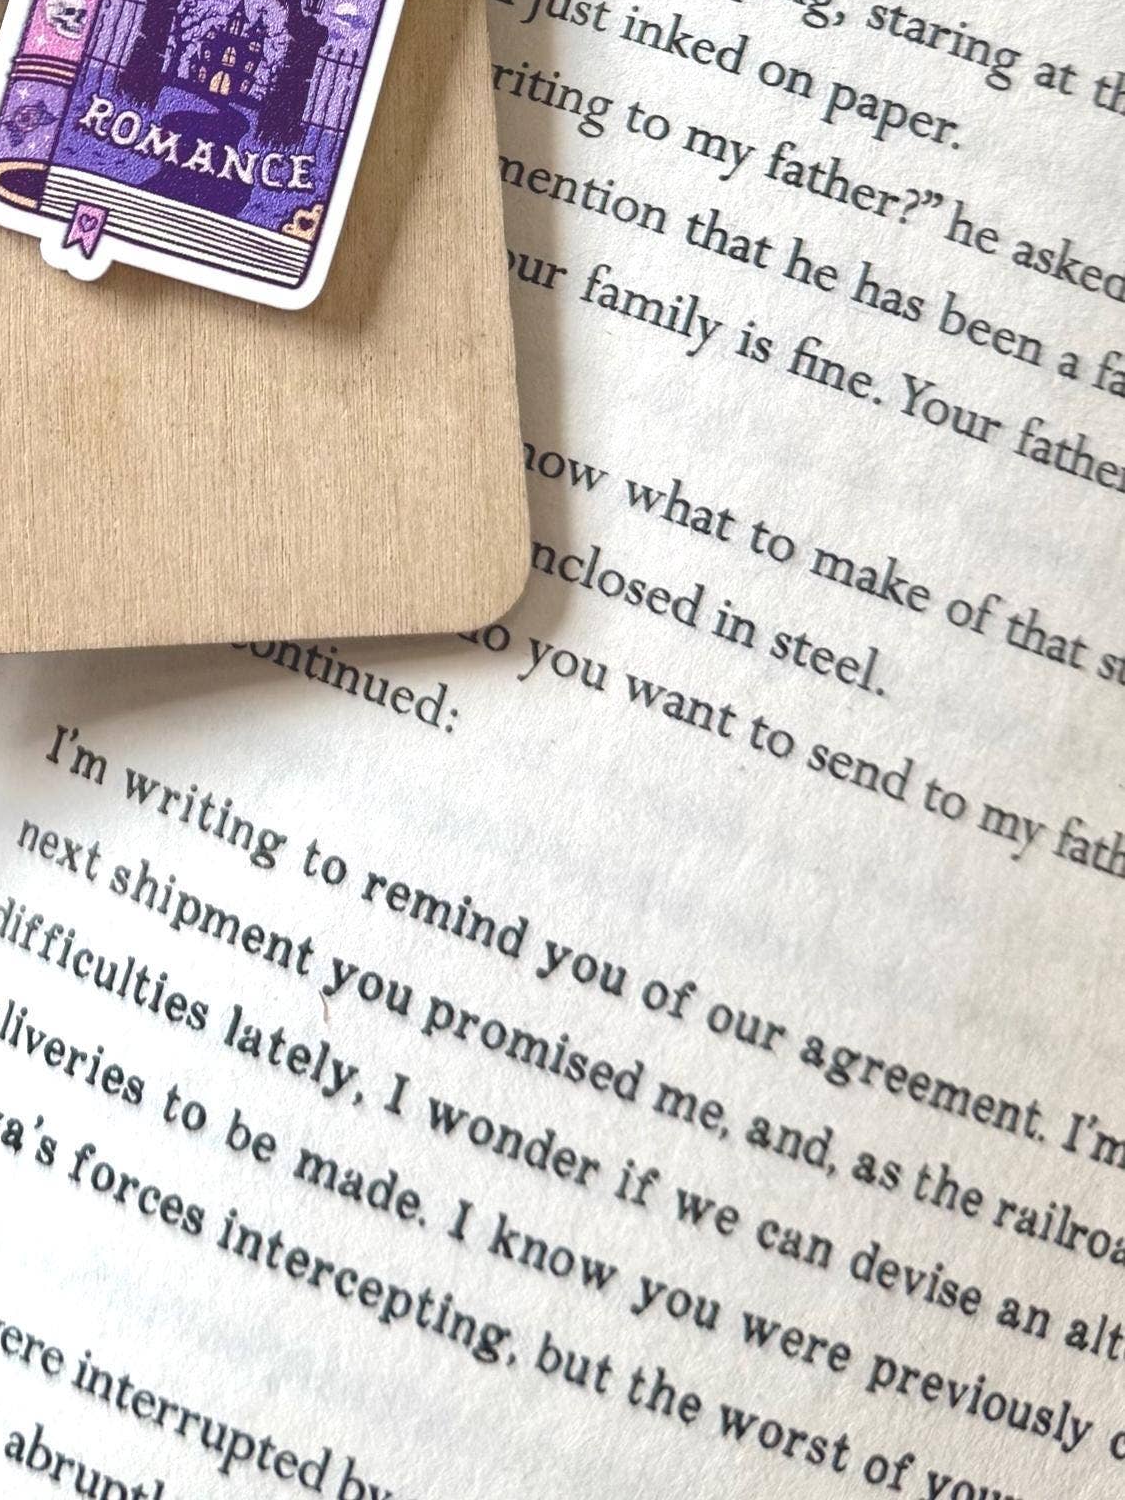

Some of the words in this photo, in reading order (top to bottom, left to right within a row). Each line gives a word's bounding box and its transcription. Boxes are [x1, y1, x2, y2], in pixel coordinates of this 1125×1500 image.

[866, 5, 1023, 92] staring
[1034, 62, 1078, 95] at
[77, 96, 317, 192] ROMANCE
[627, 102, 671, 141] to
[682, 126, 757, 182] my
[944, 201, 1000, 254] he
[626, 478, 737, 542] what
[750, 520, 797, 564] to
[810, 548, 931, 613] make
[946, 594, 1004, 635] of
[712, 600, 757, 649] in
[770, 632, 885, 697] steel.
[127, 769, 287, 870] writing
[303, 839, 348, 886] to
[361, 872, 529, 961] remind
[536, 940, 627, 998] you
[642, 980, 698, 1020] of
[707, 1004, 787, 1052] our
[799, 1036, 1045, 1143] agreement.
[68, 1143, 205, 1237] forces
[217, 1208, 516, 1368] intercepting,
[535, 1331, 613, 1396] but
[627, 1366, 702, 1427] the
[720, 1404, 850, 1474] worst
[863, 1452, 916, 1493] of
[71, 1350, 332, 1494] interrupted
